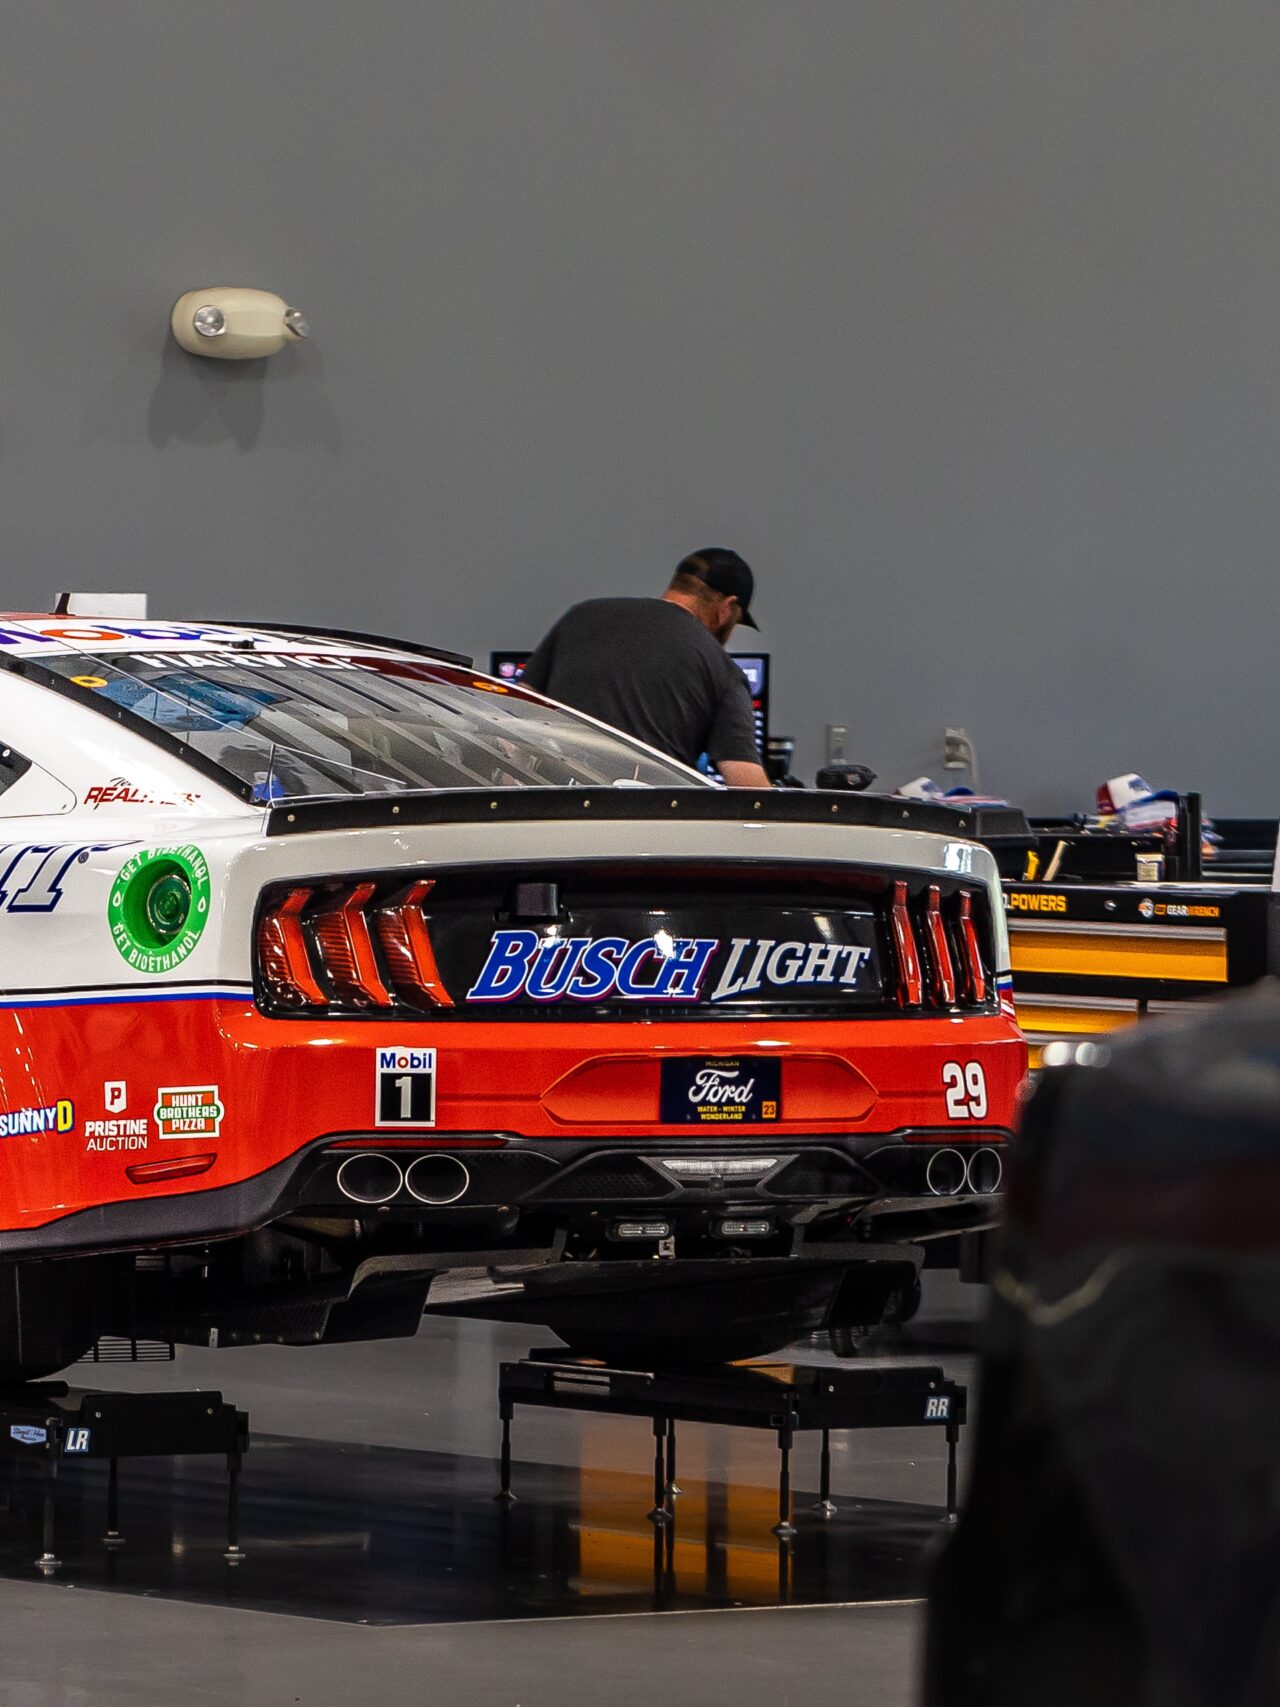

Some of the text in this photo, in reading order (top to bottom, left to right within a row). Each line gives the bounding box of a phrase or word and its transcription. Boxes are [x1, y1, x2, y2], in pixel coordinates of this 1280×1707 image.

[120, 852, 143, 882] GET
[113, 922, 201, 972] GET BIOETHANOL
[466, 930, 870, 1002] BUSCH LIGHT
[380, 1053, 432, 1069] Mobil
[688, 1069, 755, 1103] Ford
[943, 1062, 989, 1119] 29
[171, 1094, 204, 1107] HUNT
[395, 1076, 412, 1118] 1
[159, 1106, 218, 1119] BROTHERS
[763, 1105, 776, 1116] 23
[85, 1119, 148, 1137] PRISTINE
[172, 1118, 205, 1131] PIZZA
[86, 1136, 148, 1151] AUCTION
[925, 1396, 949, 1417] RR
[66, 1429, 89, 1451] LR
